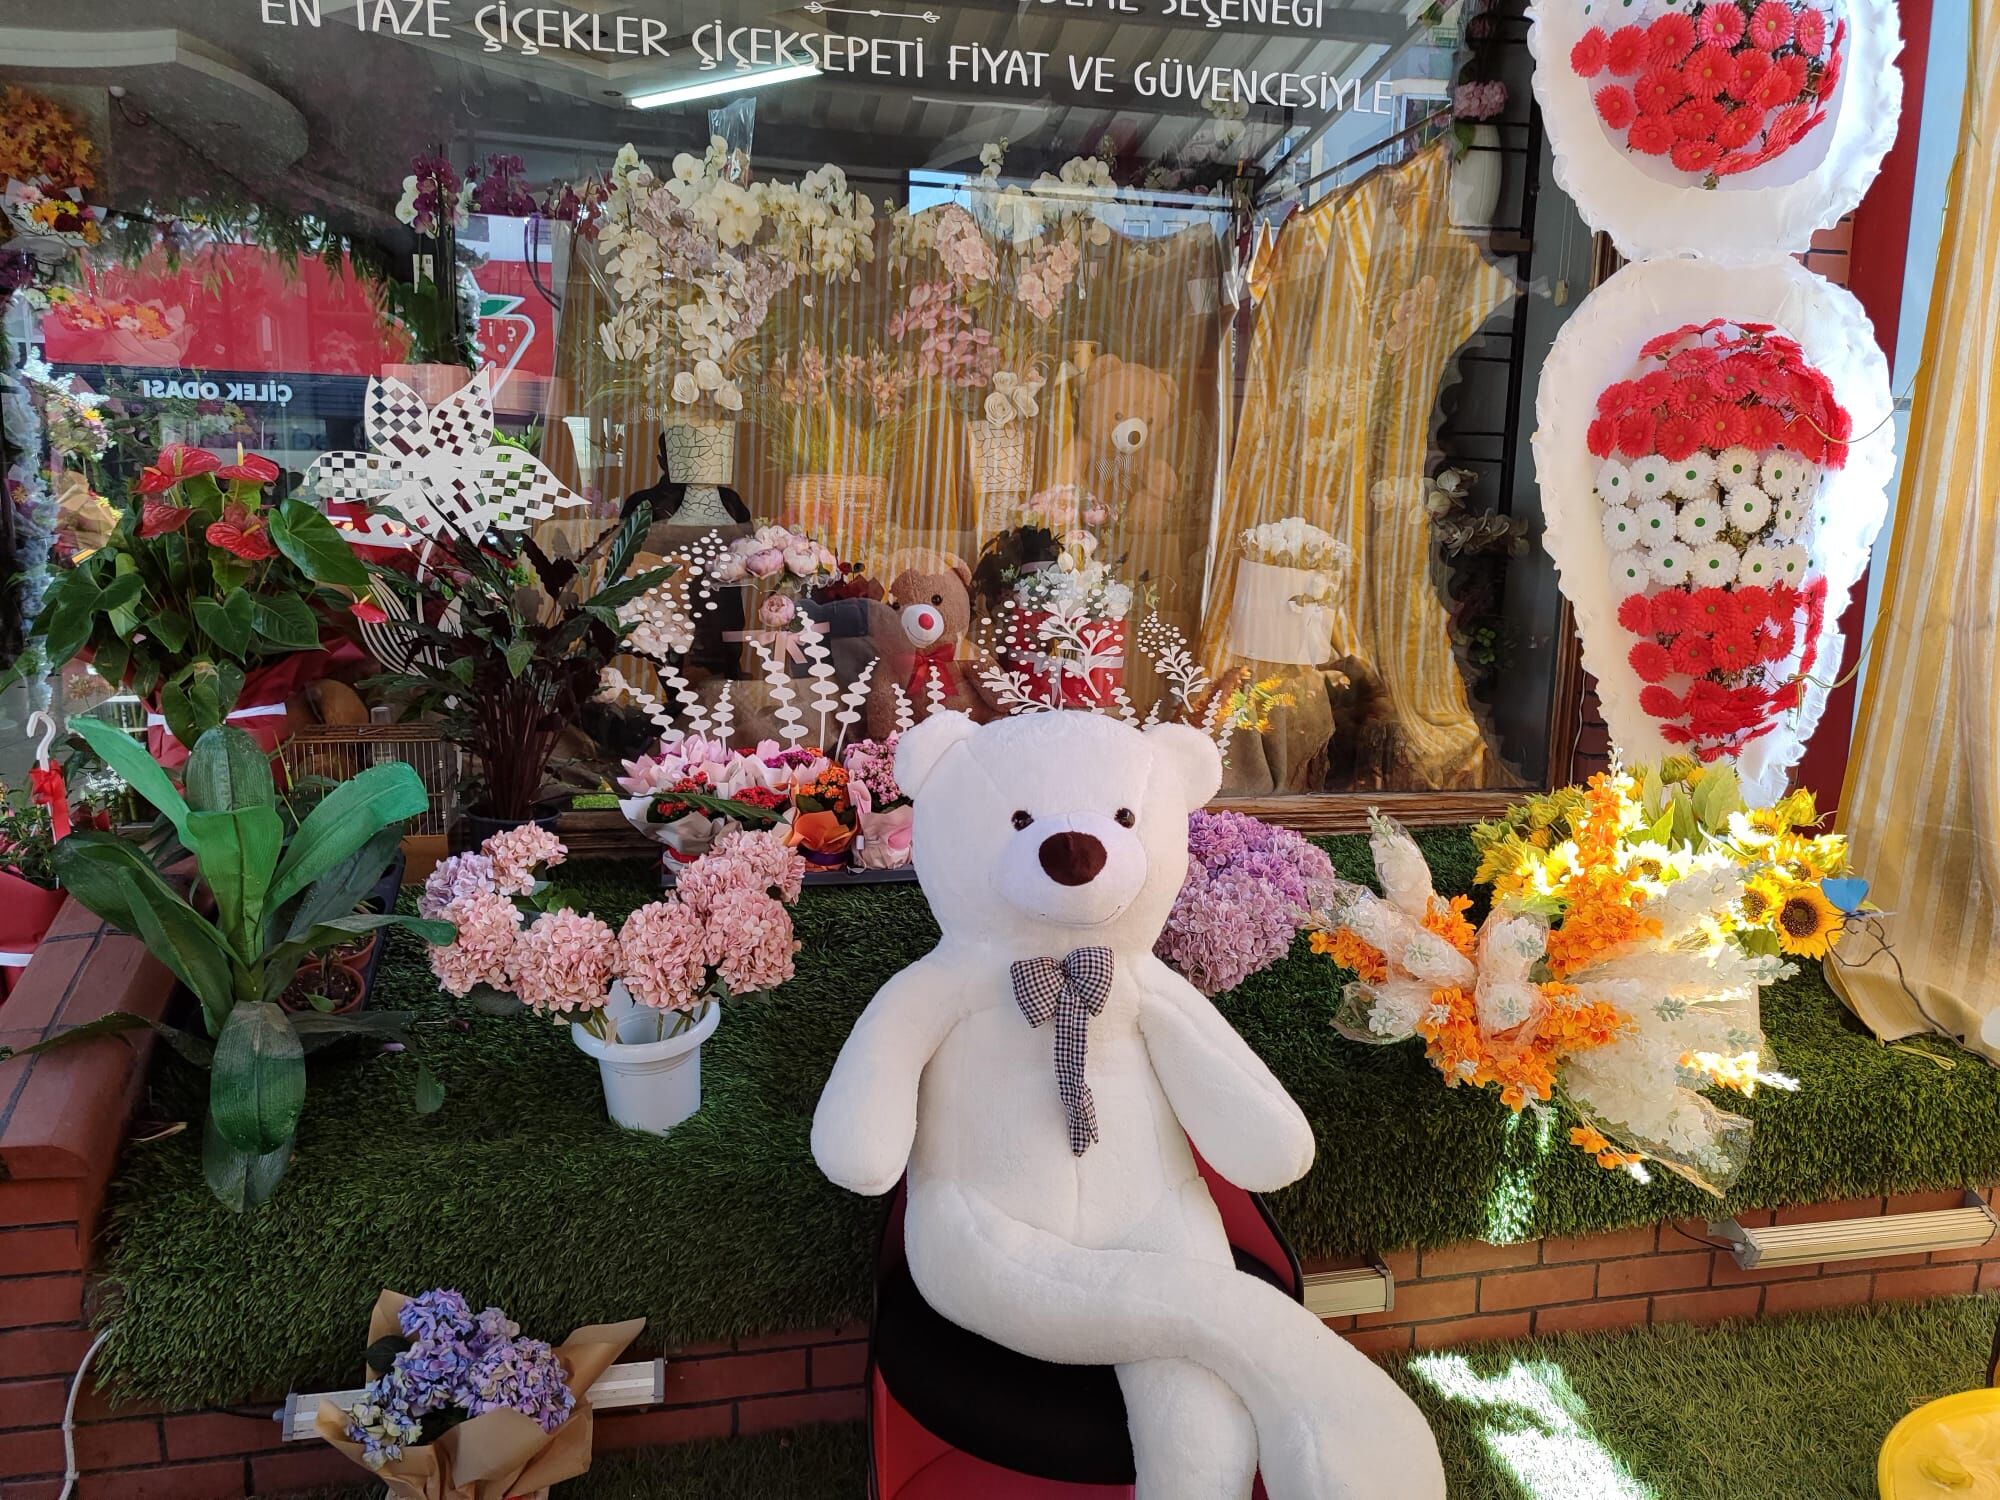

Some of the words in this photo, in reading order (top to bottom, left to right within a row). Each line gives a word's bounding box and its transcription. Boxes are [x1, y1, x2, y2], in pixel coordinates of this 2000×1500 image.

[261, 0, 321, 27] EN
[355, 0, 451, 38] TAZE
[474, 0, 670, 56] ÇİÇEKLER
[692, 20, 924, 80] ÇİÇEKSEPETİ
[948, 42, 1050, 87] FİYAT
[1068, 56, 1116, 93] VE
[1134, 56, 1394, 115] GÜVENCESİYLE
